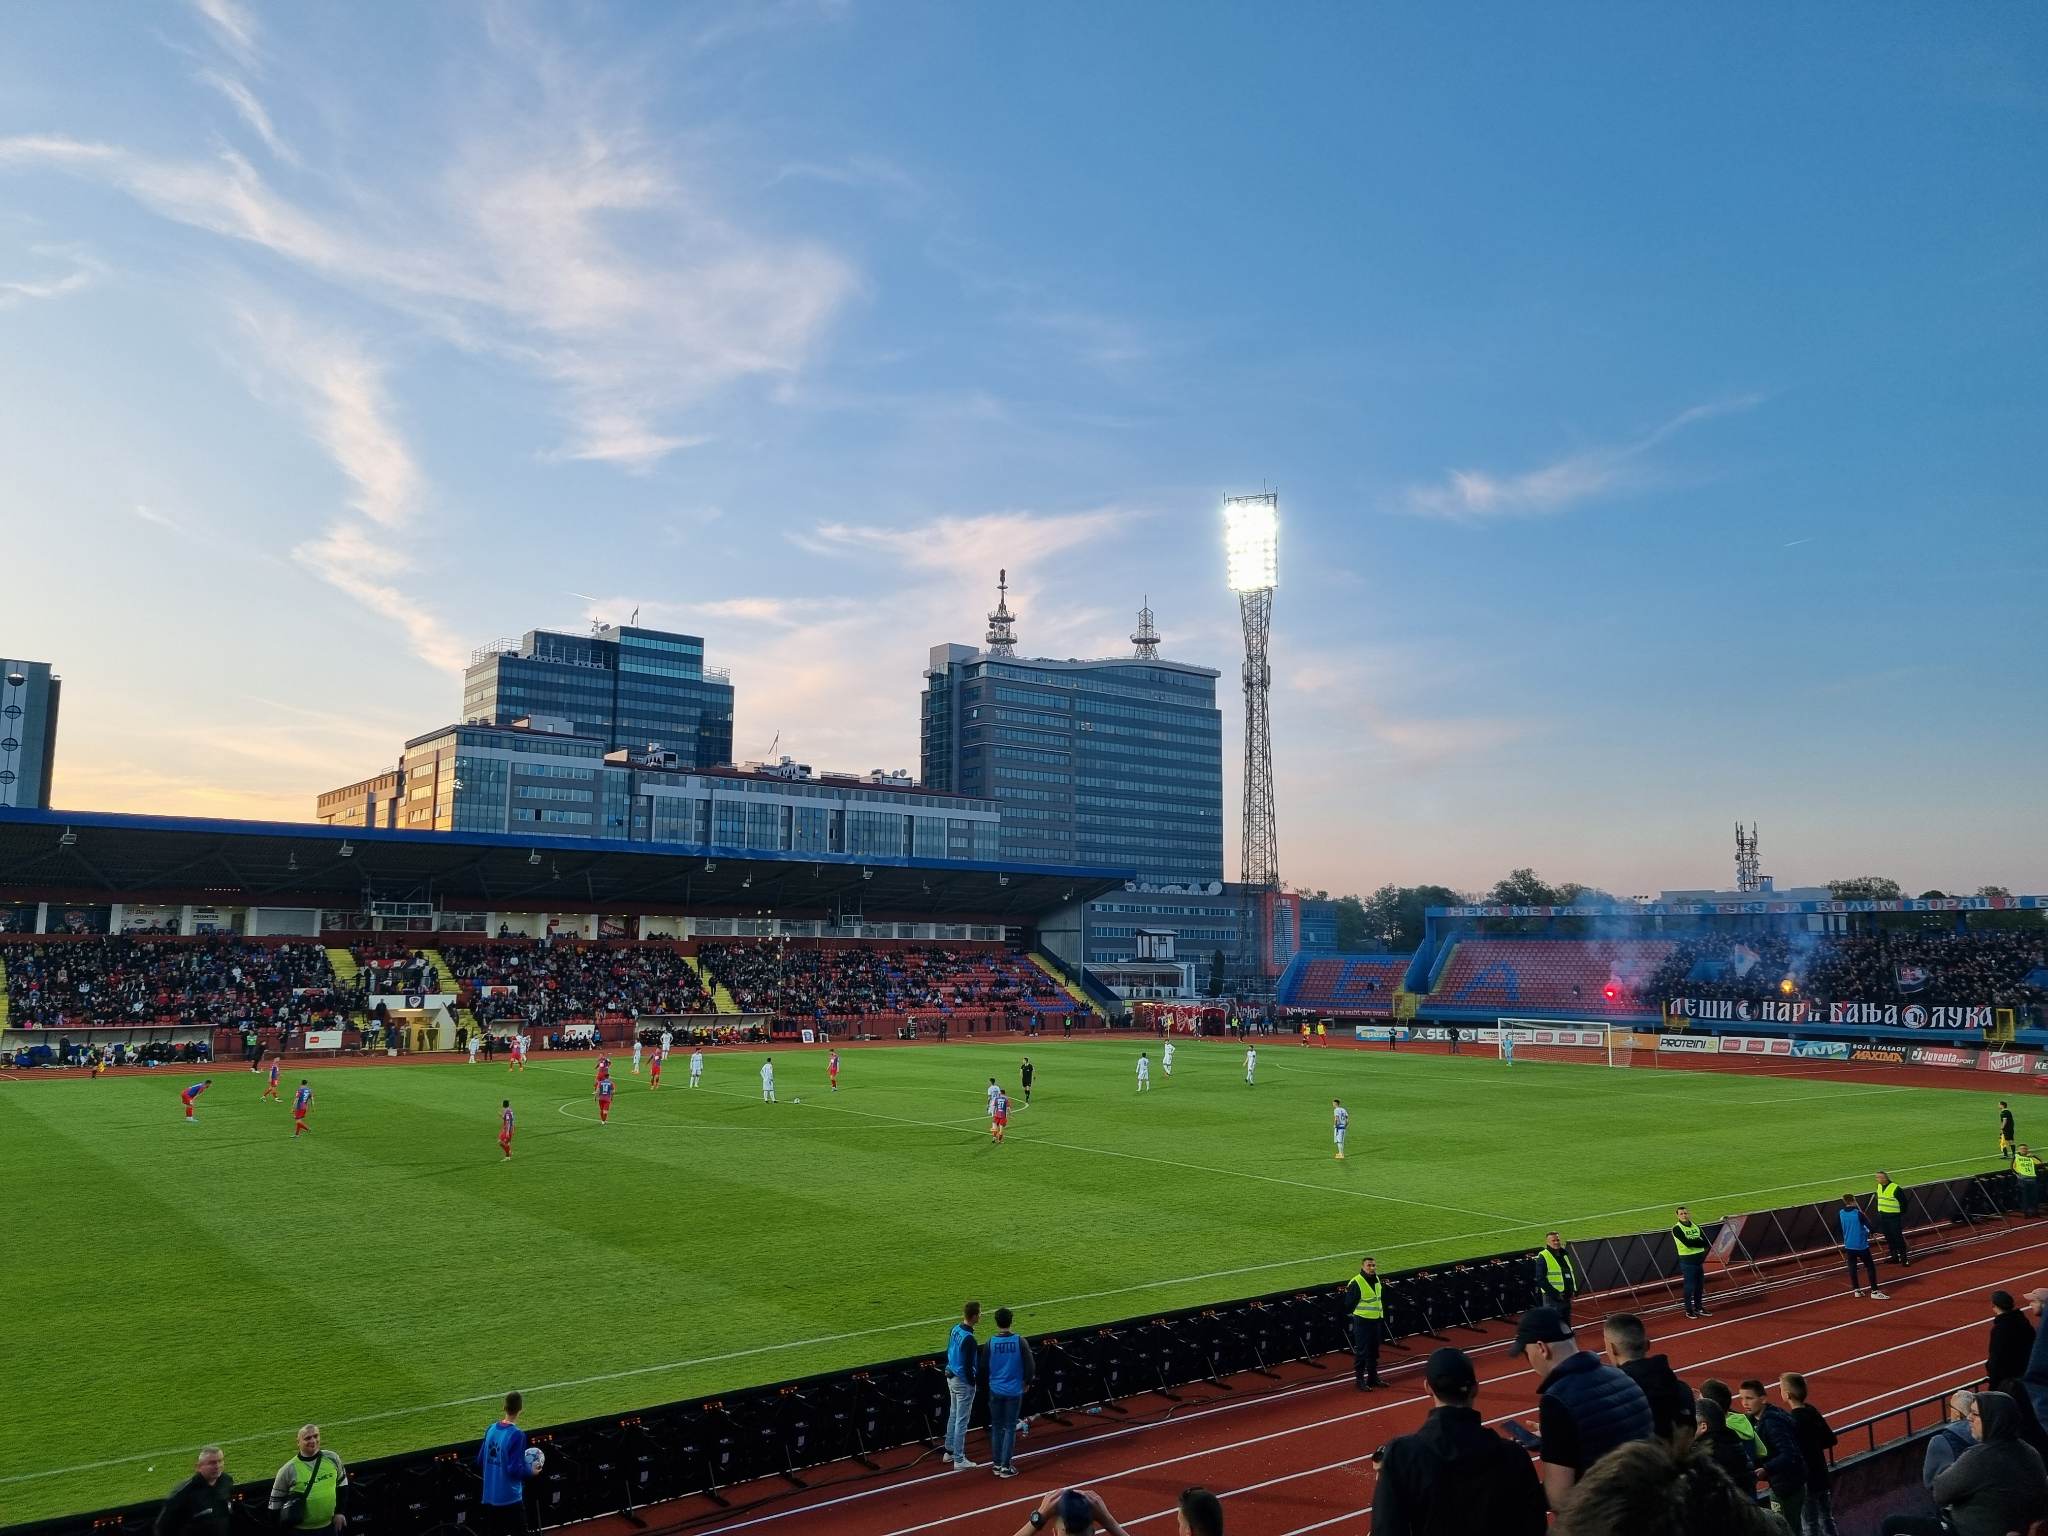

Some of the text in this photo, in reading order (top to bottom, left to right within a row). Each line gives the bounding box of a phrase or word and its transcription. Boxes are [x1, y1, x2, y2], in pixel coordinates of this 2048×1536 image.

[1450, 907, 1503, 917] НЕКА
[1512, 907, 1542, 917] МЕ
[1912, 898, 1994, 911] БОРАЦ
[2004, 898, 2021, 909] И
[1671, 998, 1733, 1019] ЛЕШИ
[1830, 1002, 1898, 1025] БАЊА
[1930, 1006, 1994, 1028] ЛУКА
[1427, 1028, 1477, 1041] SELCT
[1922, 1051, 1957, 1063] Juventa
[1991, 1055, 2023, 1070] Nektar
[994, 1342, 1017, 1354] FOTO
